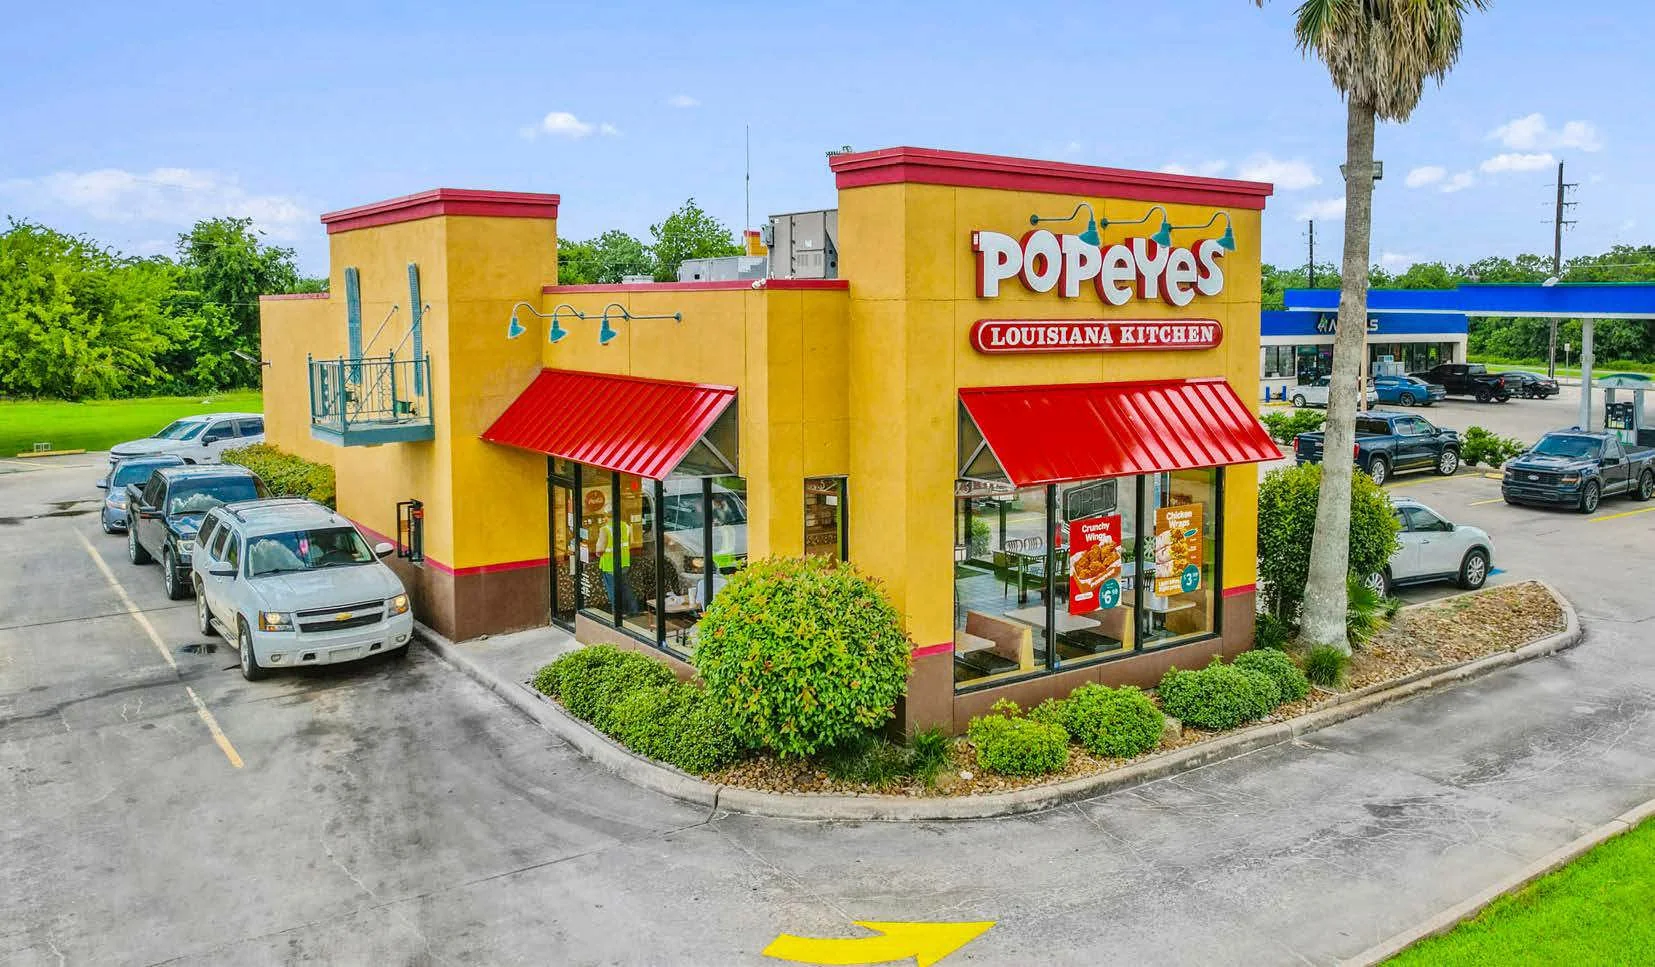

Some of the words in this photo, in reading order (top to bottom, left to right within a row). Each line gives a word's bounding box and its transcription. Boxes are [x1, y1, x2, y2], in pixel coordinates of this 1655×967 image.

[990, 327, 1113, 346] LOUISIANA
[1119, 325, 1214, 344] KITCHEN
[1166, 511, 1193, 520] Chicken
[1081, 522, 1110, 533] Crunchy
